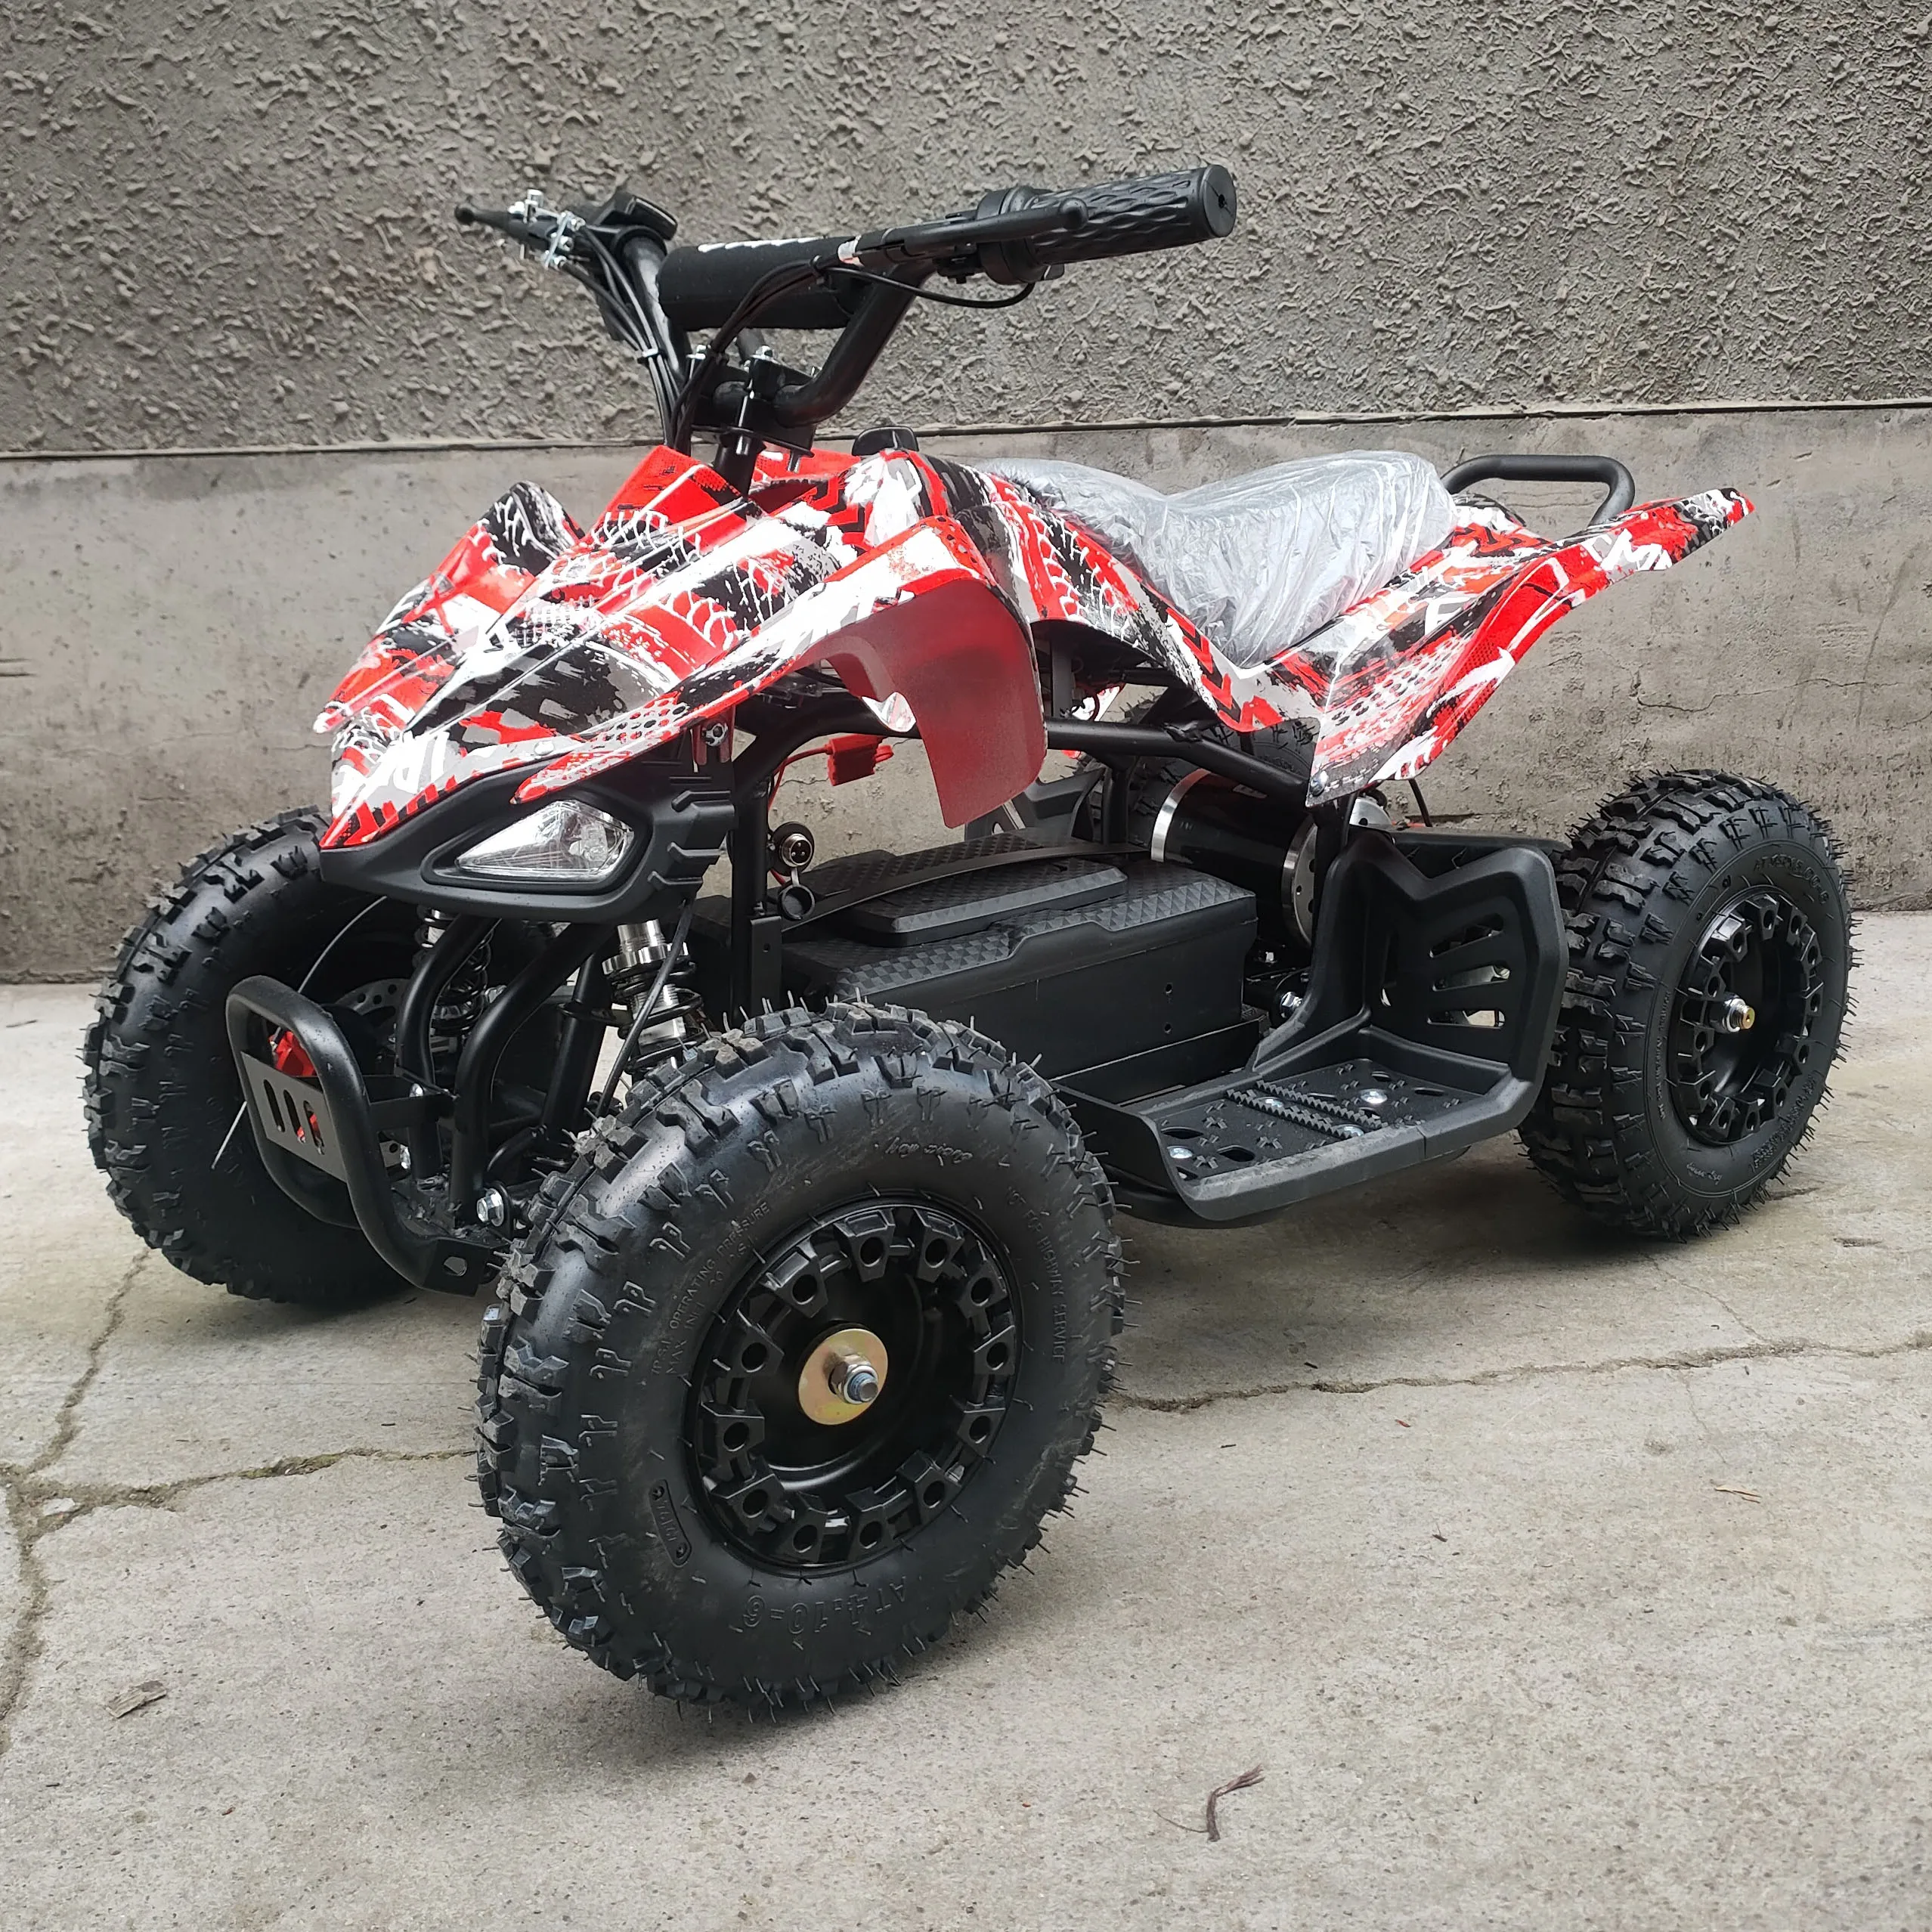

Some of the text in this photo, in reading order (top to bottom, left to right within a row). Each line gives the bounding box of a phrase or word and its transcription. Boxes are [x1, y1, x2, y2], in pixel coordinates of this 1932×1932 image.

[670, 1258, 716, 1330] OPERATING
[716, 1201, 770, 1257] PRESSURE
[1036, 1236, 1065, 1295] HIGHWAY
[1052, 1303, 1068, 1364] SERVICE
[665, 1339, 688, 1374] MAX
